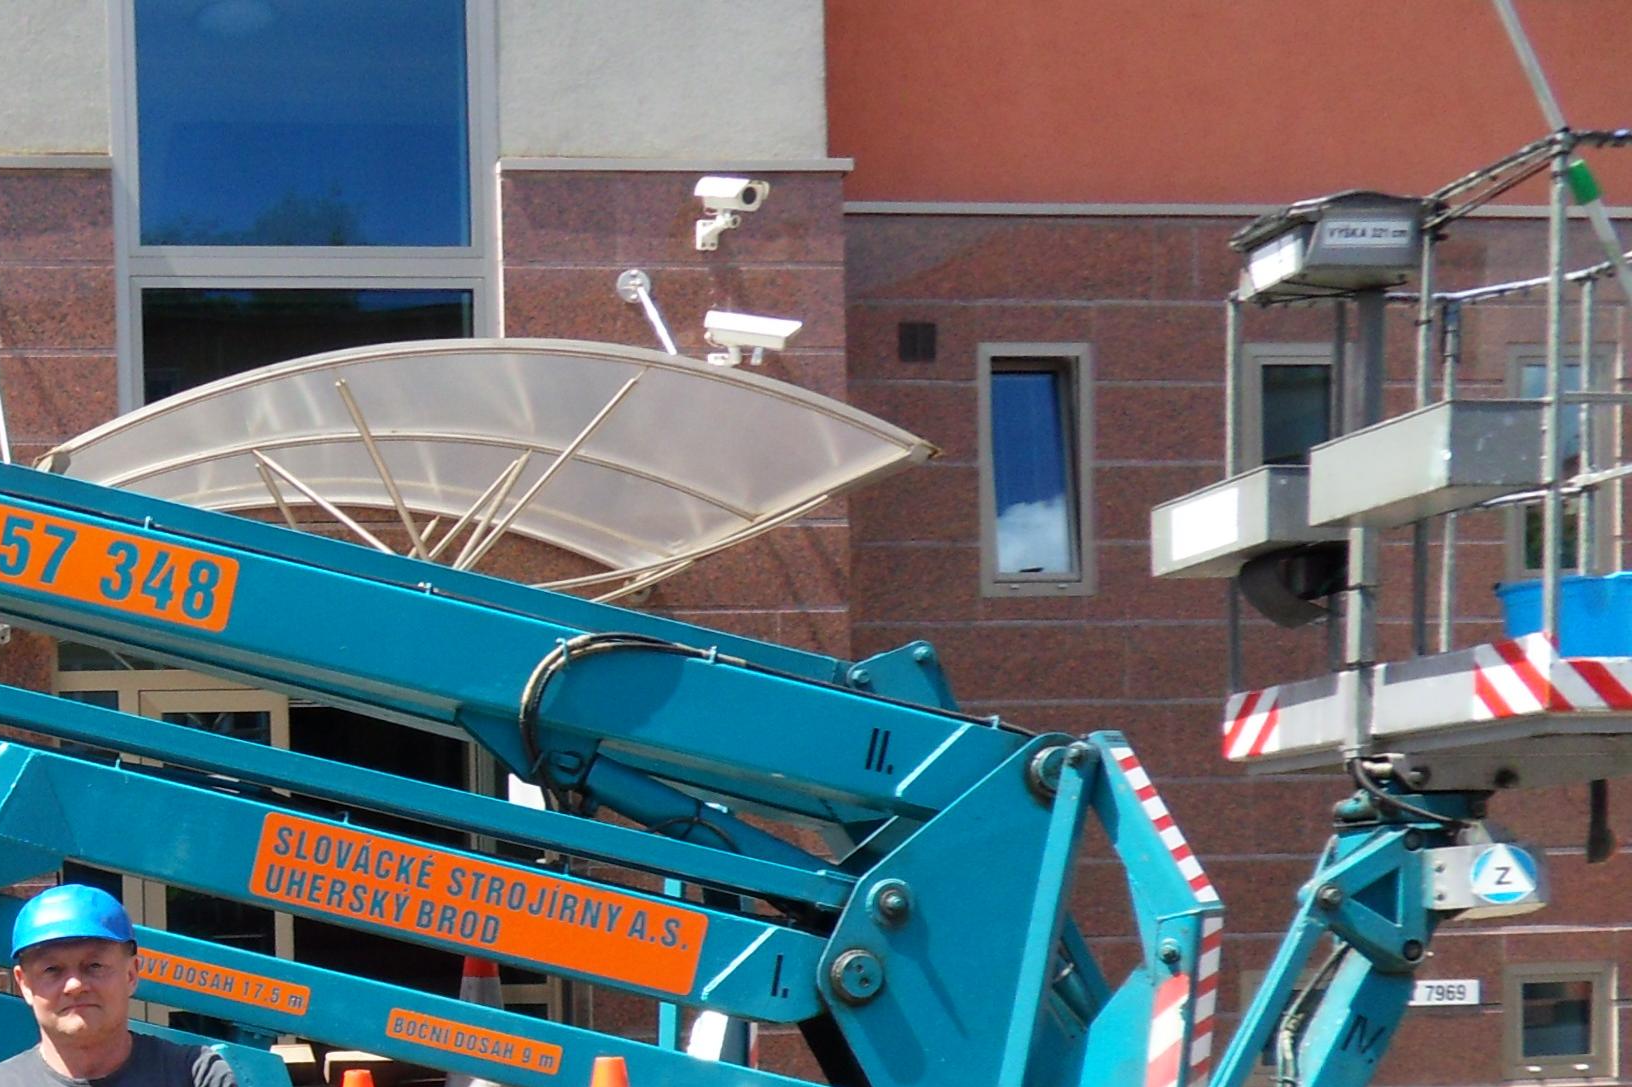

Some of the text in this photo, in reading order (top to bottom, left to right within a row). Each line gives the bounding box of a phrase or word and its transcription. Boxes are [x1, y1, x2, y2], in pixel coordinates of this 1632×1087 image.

[99, 539, 222, 621] 348
[274, 825, 689, 951] SLOVÁCKÉ STROJÍRNY A.S.
[1494, 866, 1513, 886] Z
[265, 863, 501, 944] UHERSKÝ BROD
[172, 963, 235, 994] DOSAH
[287, 993, 304, 1009] m
[1425, 984, 1467, 1002] 7969
[453, 1031, 515, 1060] DOSAH
[522, 1047, 532, 1063] 9
[539, 1054, 555, 1069] m
